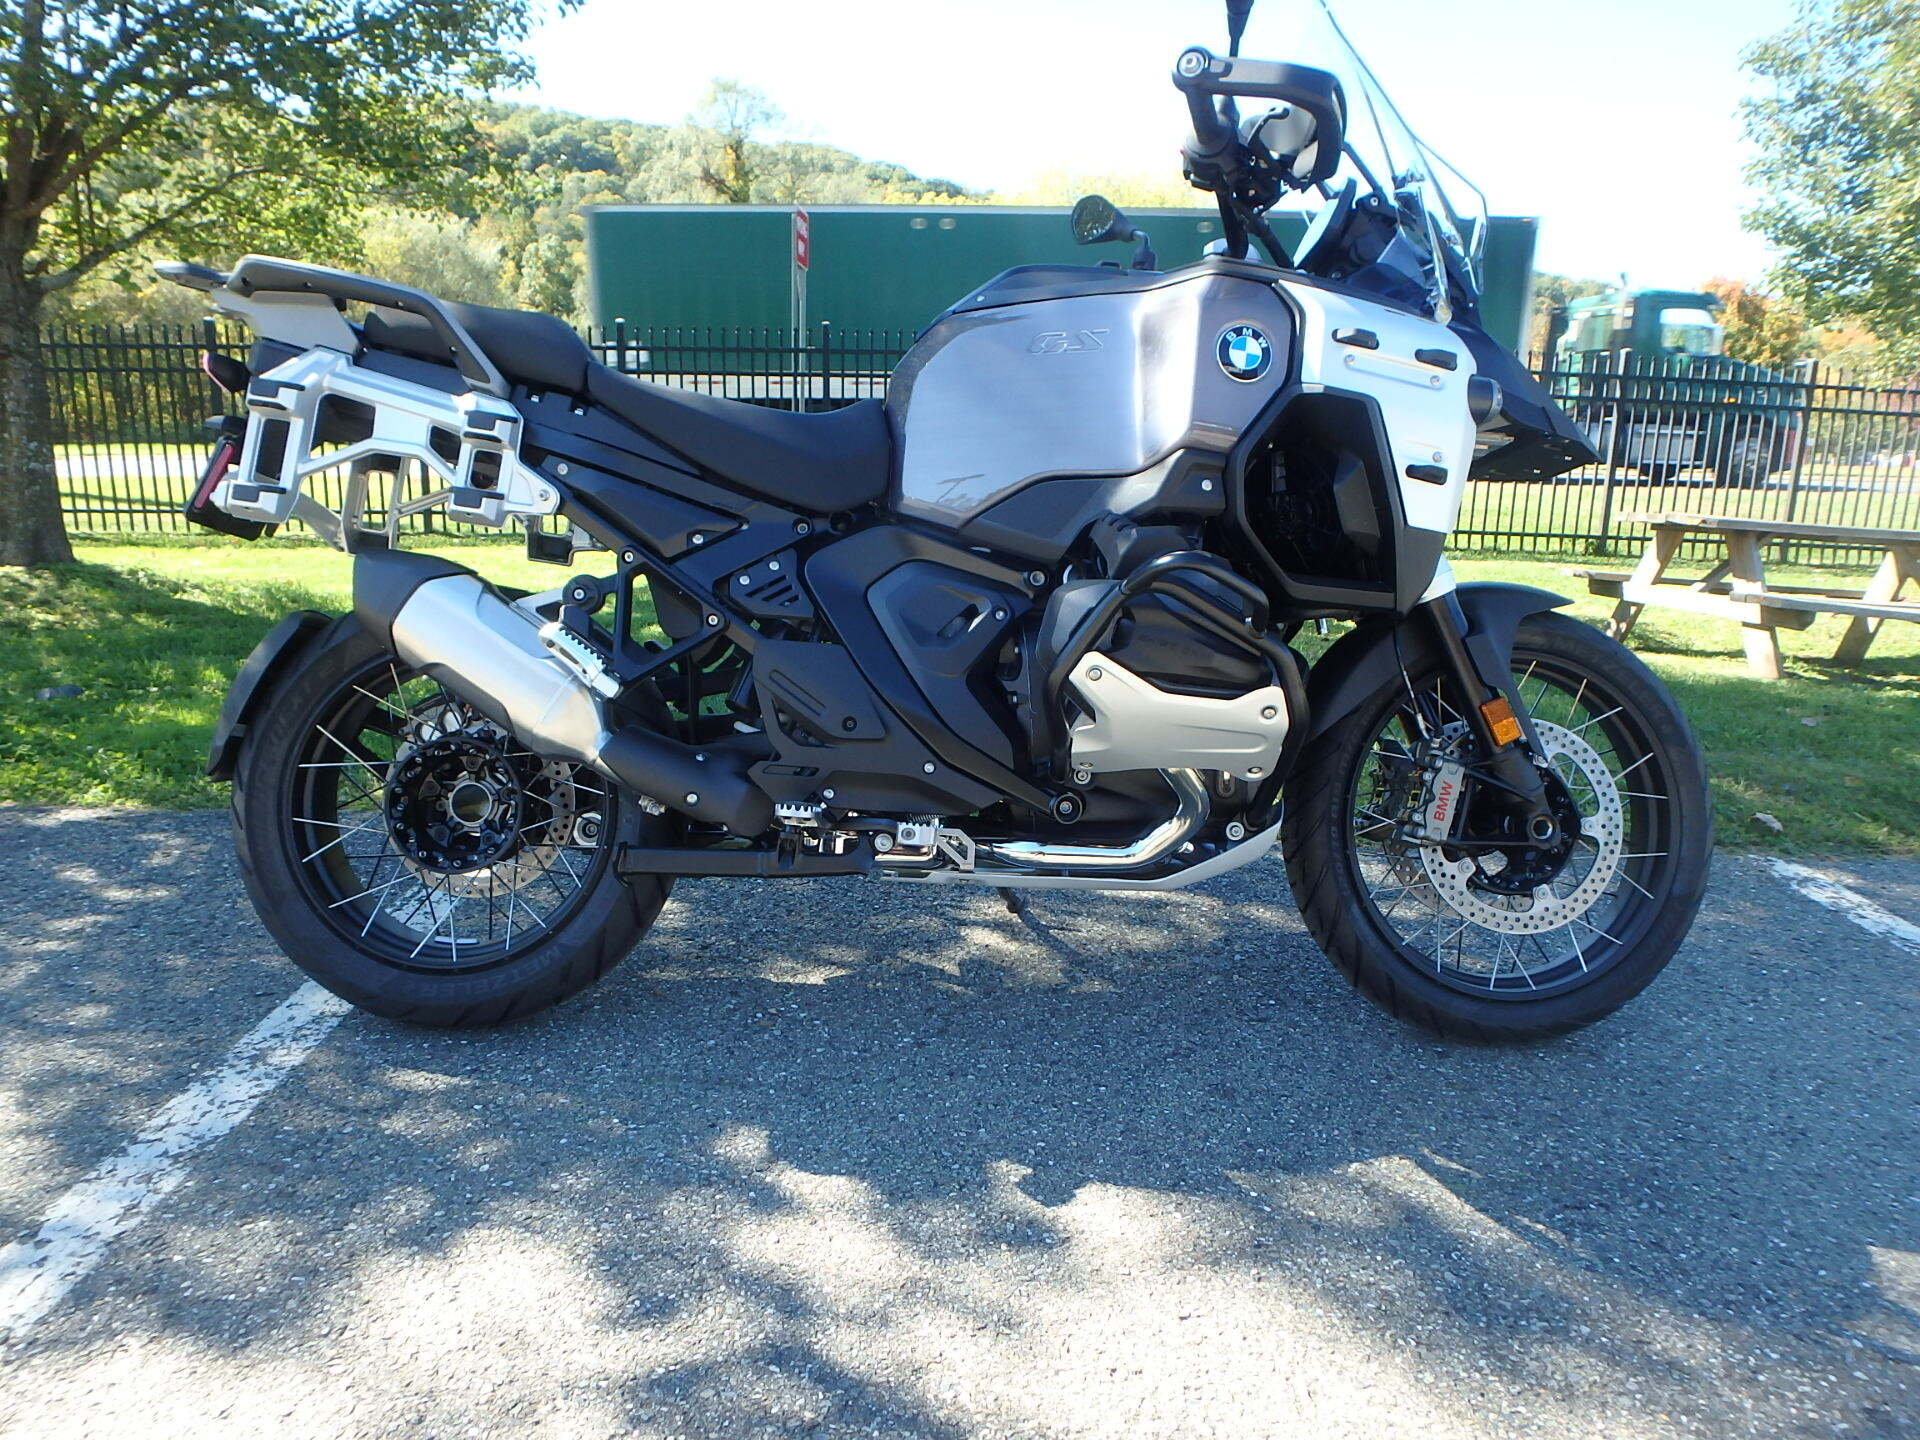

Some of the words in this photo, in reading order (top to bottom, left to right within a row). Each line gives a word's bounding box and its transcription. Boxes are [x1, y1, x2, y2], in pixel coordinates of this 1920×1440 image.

[1027, 329, 1111, 355] GS
[1226, 327, 1268, 348] BMW
[1434, 780, 1454, 822] BMW
